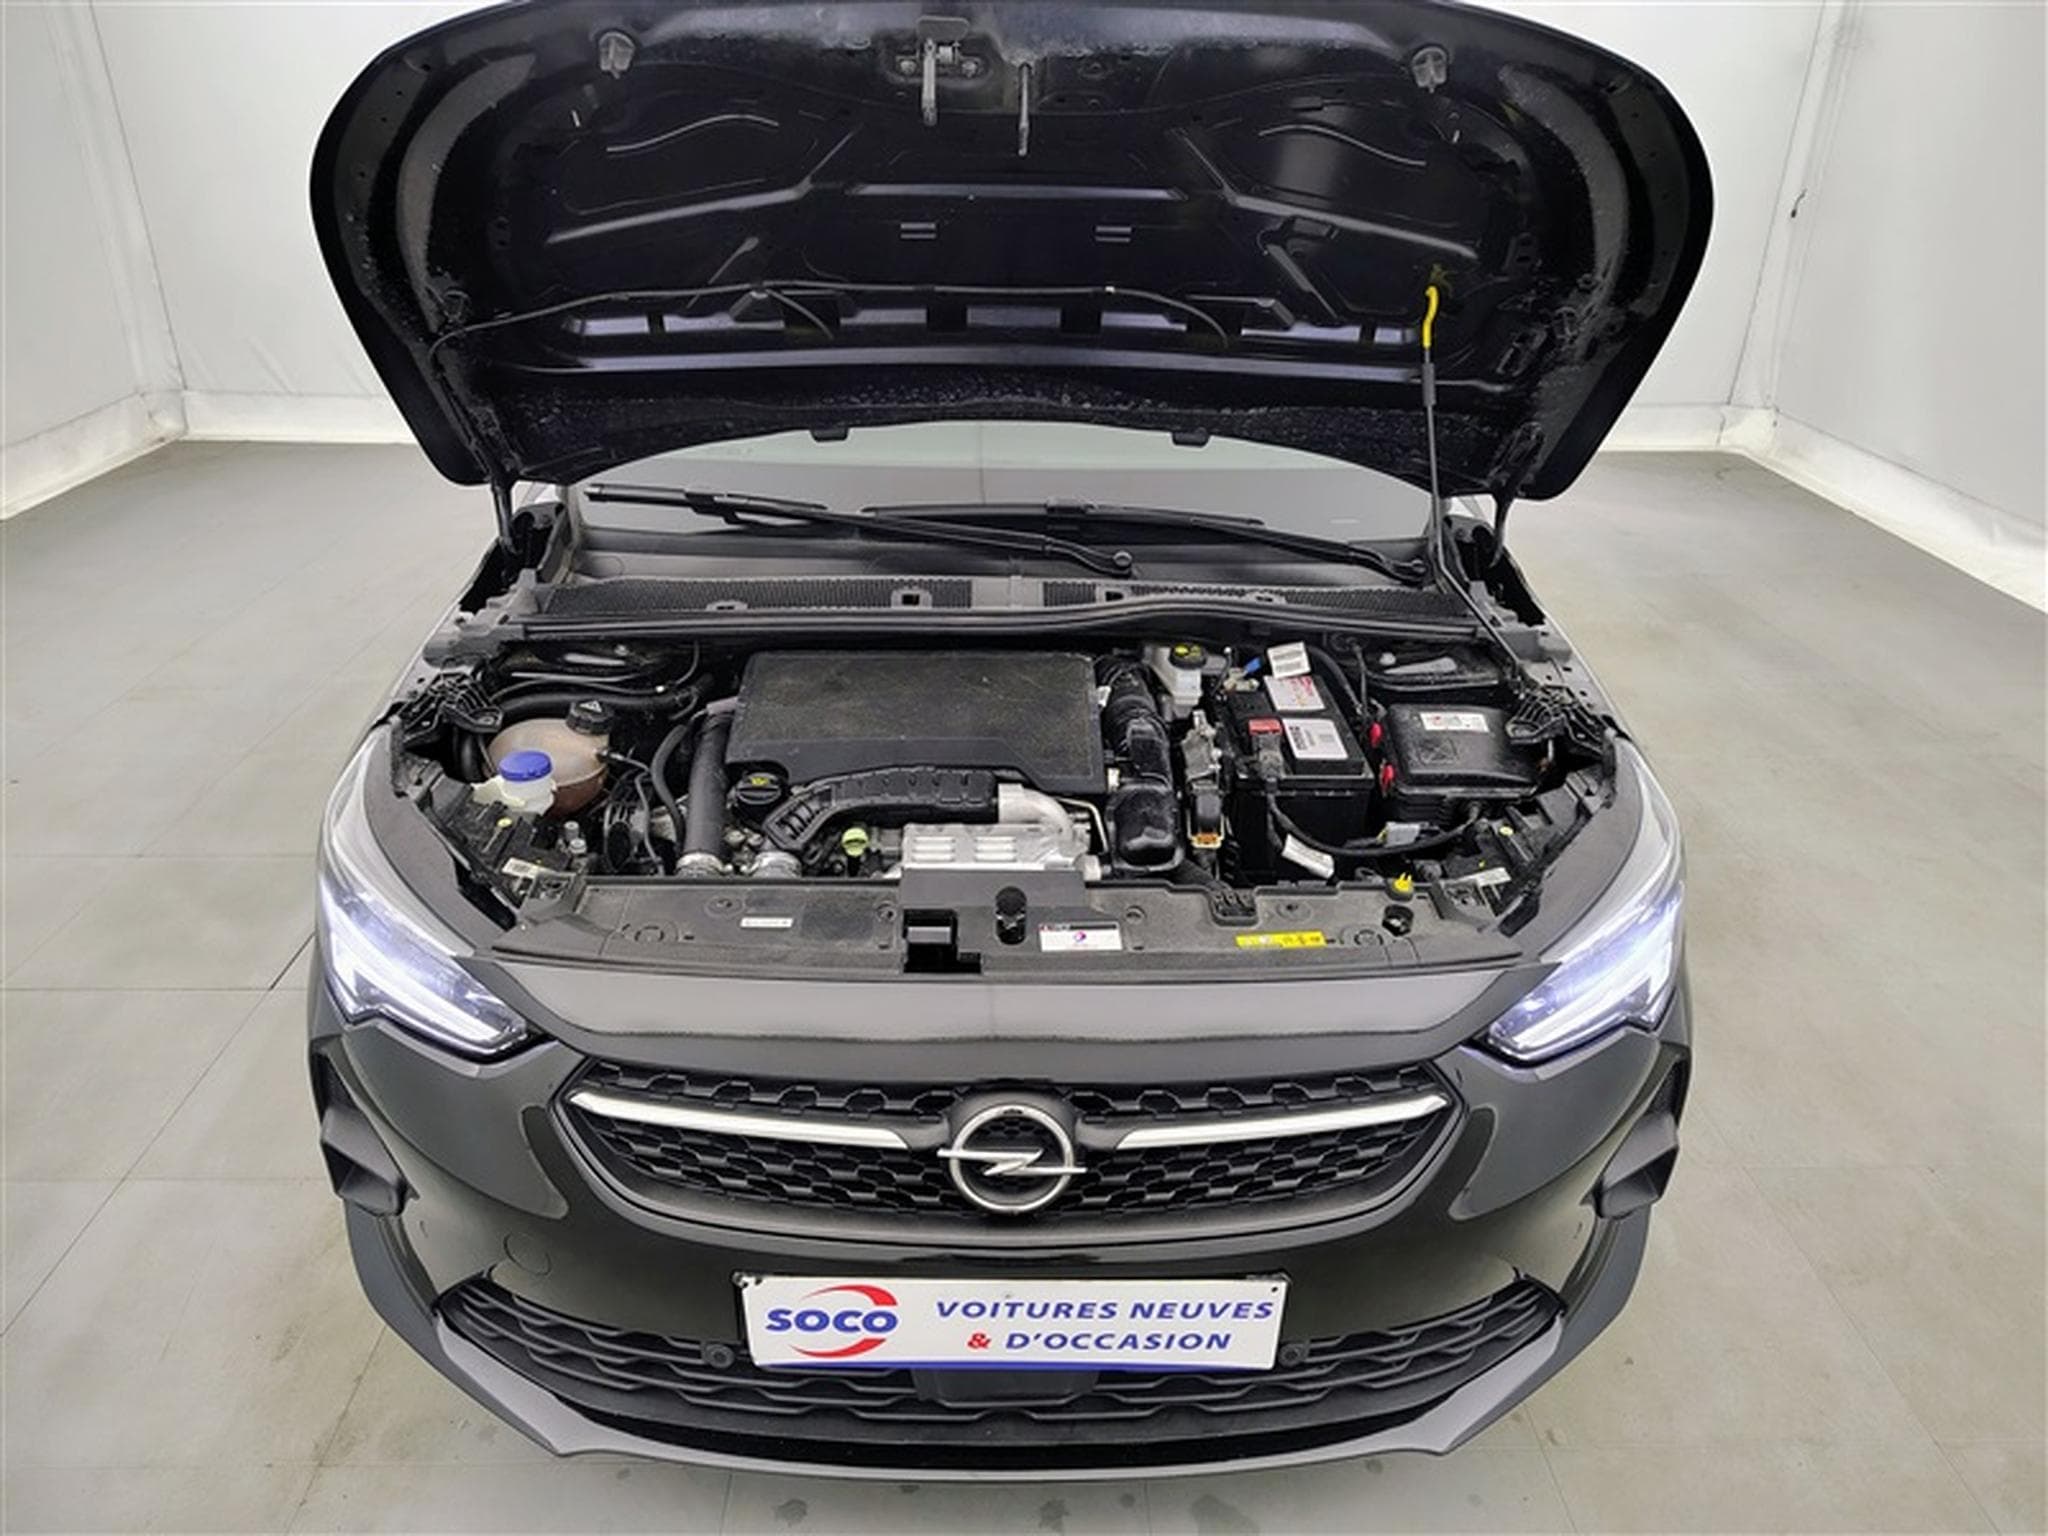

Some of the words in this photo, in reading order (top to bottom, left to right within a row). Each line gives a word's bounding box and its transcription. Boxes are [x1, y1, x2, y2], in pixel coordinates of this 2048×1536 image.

[936, 1301, 1118, 1320] VOITURES
[1130, 1301, 1274, 1320] NEUVES
[765, 1308, 899, 1335] SOCO
[967, 1332, 991, 1350] &
[1005, 1332, 1232, 1350] D'OCCASION
